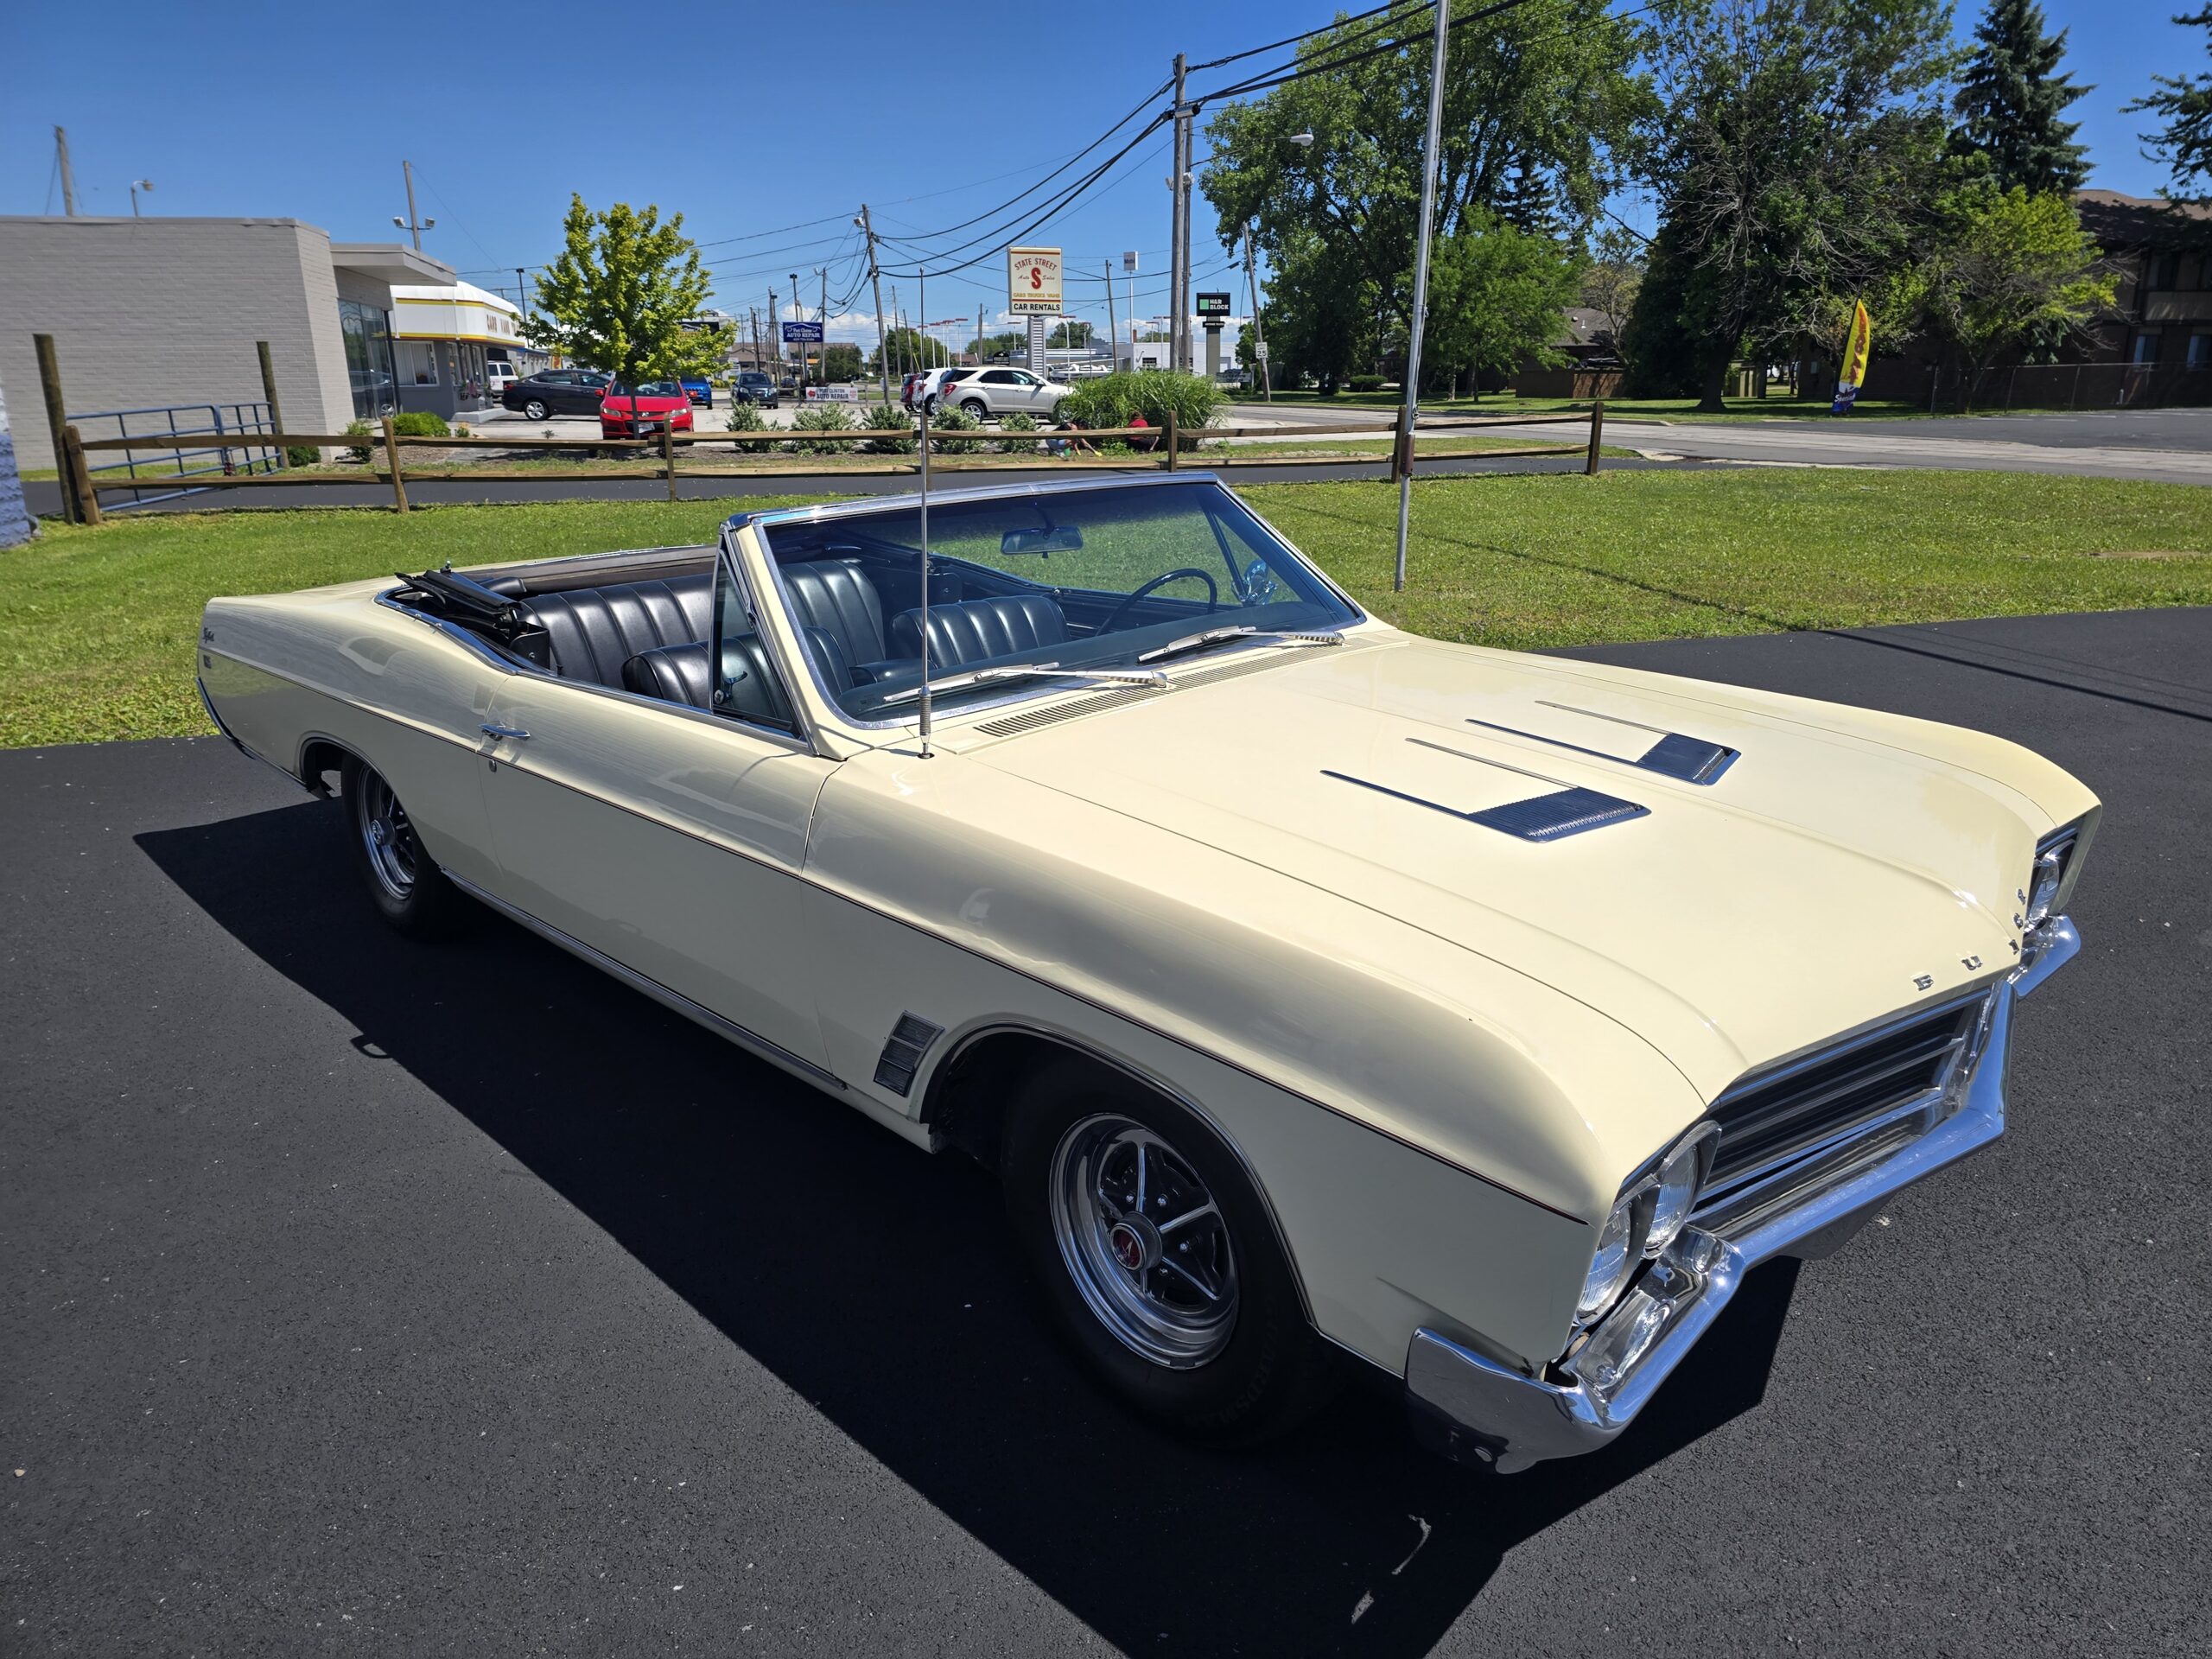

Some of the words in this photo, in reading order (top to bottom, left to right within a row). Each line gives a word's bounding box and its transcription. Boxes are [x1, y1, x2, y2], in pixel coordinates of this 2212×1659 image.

[1014, 257, 1033, 270] STATE
[1035, 258, 1057, 271] STREET
[1031, 267, 1041, 289] S
